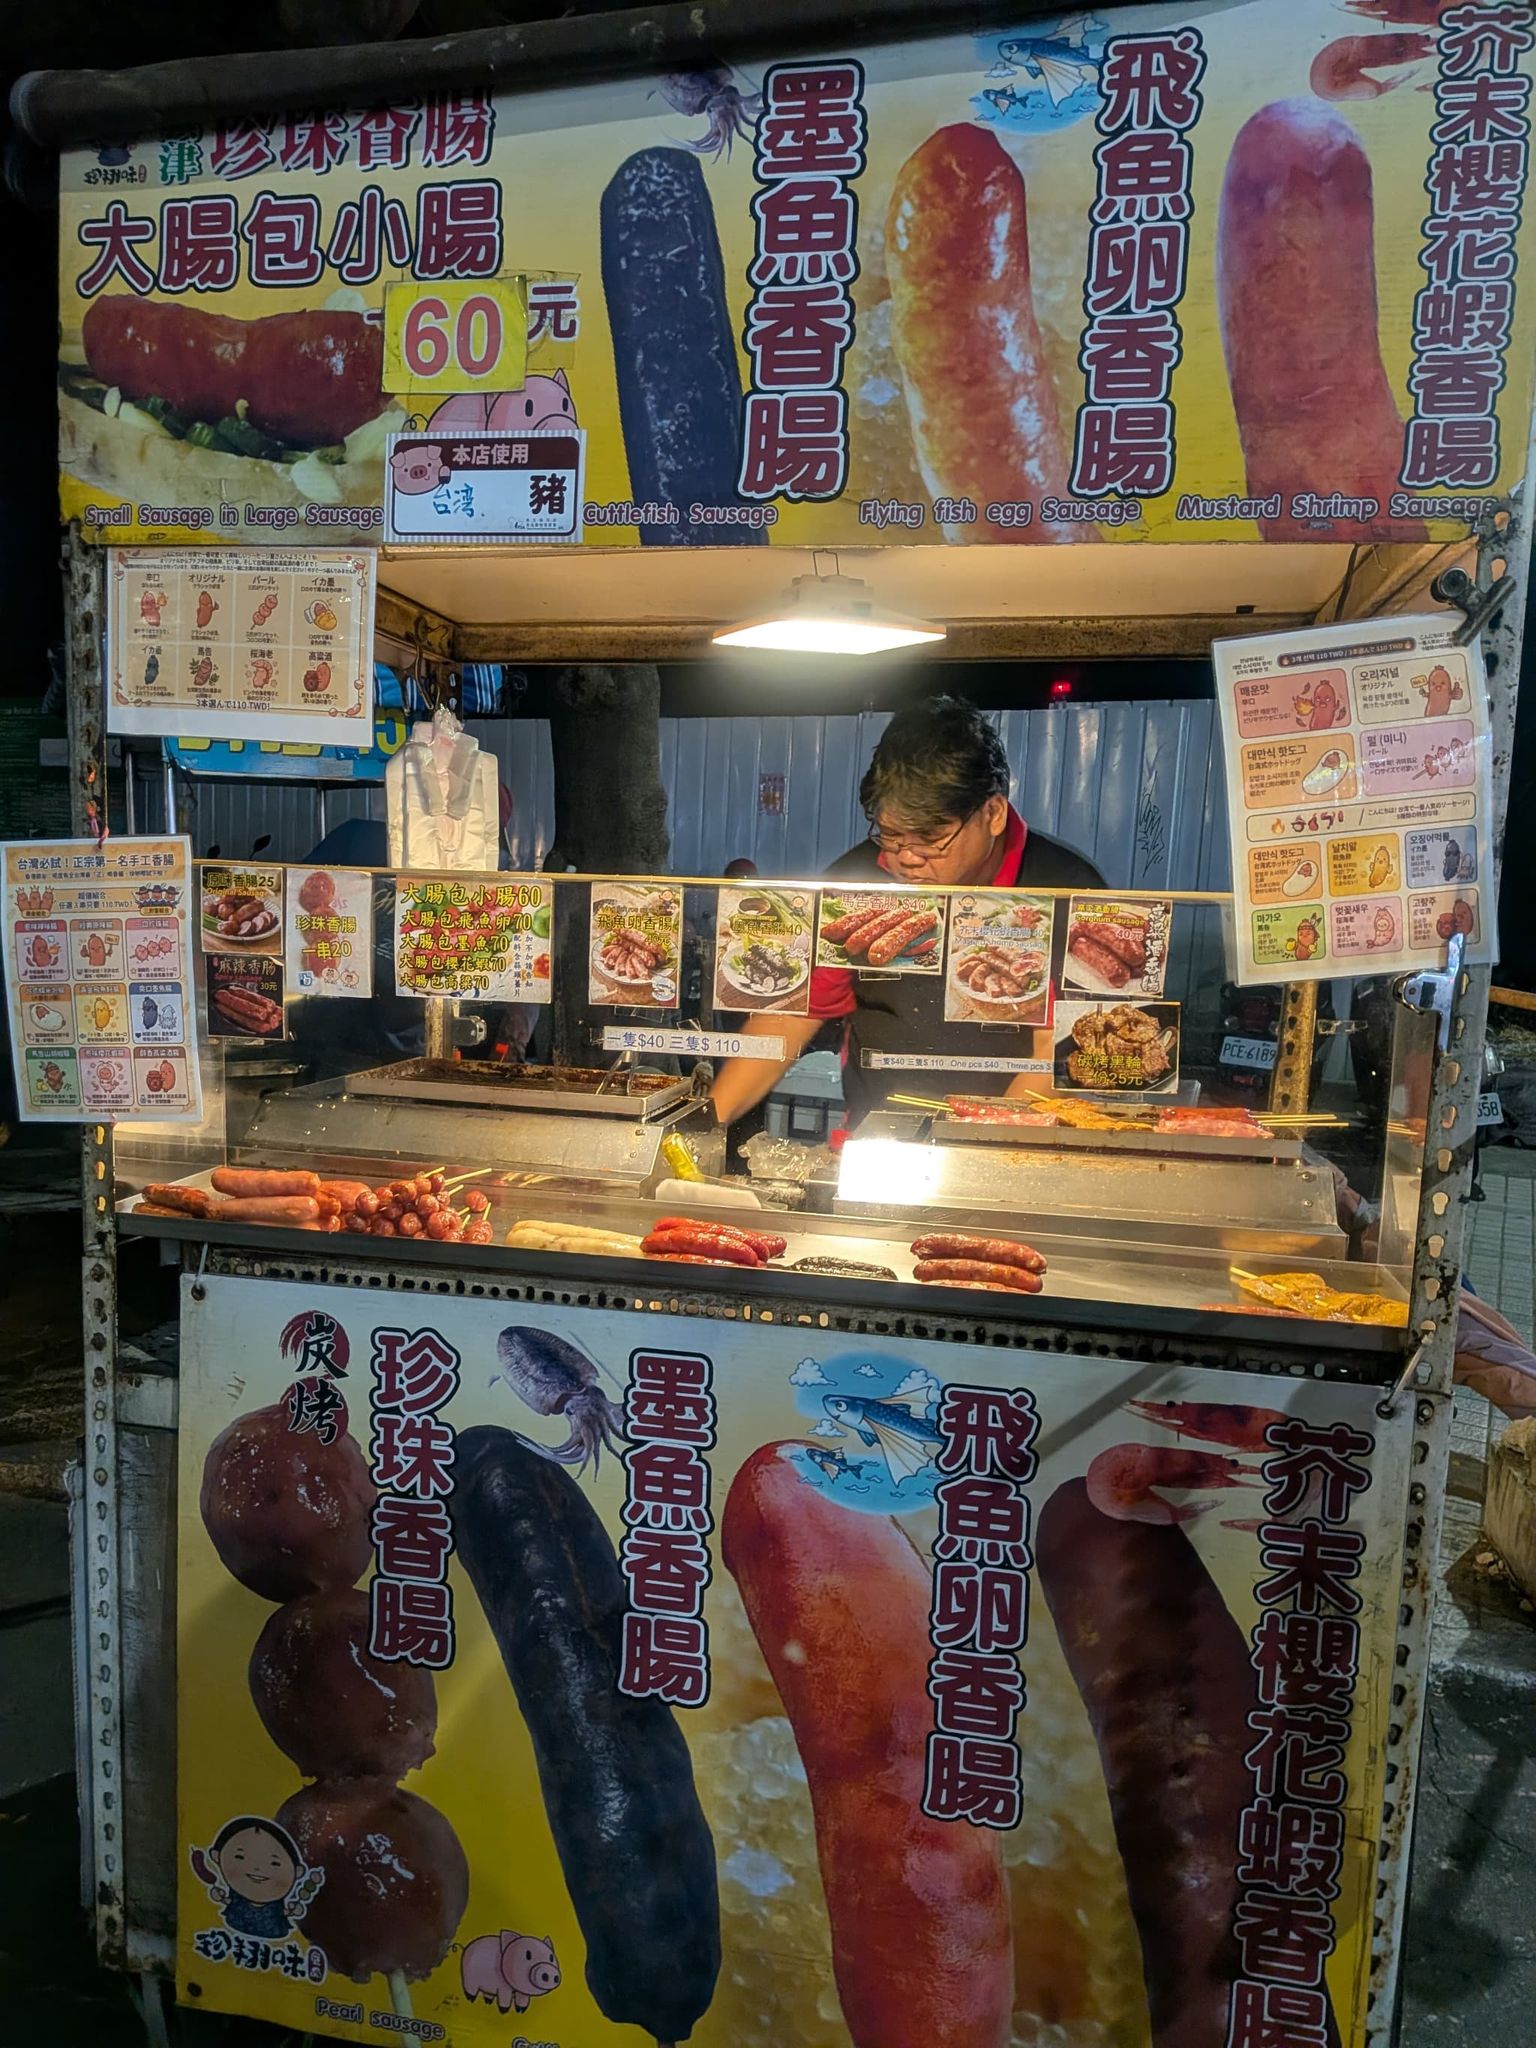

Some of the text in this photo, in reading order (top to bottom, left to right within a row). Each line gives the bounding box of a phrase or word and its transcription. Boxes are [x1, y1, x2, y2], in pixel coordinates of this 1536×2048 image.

[76, 179, 502, 298] 大腸包小腸
[1400, 5, 1534, 489] 芥末櫻花蝦香腸
[1070, 26, 1204, 497] 飛魚卵香腸
[737, 59, 866, 502] 墨魚香腸
[405, 296, 502, 378] 60
[452, 443, 529, 465] 本店使用
[529, 473, 567, 515] 豬
[85, 503, 384, 529] Small Sausage in Large Sausage
[582, 501, 679, 528] Cuttlefish
[687, 502, 778, 528] Sausage
[858, 498, 1142, 528] Flying fish egg Sausage
[1175, 495, 1281, 522] Mustard
[1291, 495, 1379, 524] Shrimp
[188, 574, 225, 583] オリジナル
[1360, 667, 1399, 680] 오리지널
[1361, 680, 1394, 690] オリジナル
[1380, 732, 1407, 746] (미니)
[1247, 744, 1307, 760] 대만식 핫도그
[1254, 850, 1278, 861] 대만식
[401, 882, 542, 907] 大腸包小腸60
[842, 892, 927, 911] 馬告香腸 $40
[295, 914, 357, 934] 珍珠香腸
[400, 911, 532, 931] 大腸包飛魚卵70
[598, 914, 672, 931] 飛魚卵香腸
[400, 933, 509, 952] 大腸包墨魚70
[1116, 928, 1144, 941] 40元
[302, 941, 352, 959] 一串20
[400, 954, 507, 972] 大腸包櫻花蝦70
[260, 982, 278, 991] 30元
[716, 1039, 740, 1053] 110
[951, 1060, 967, 1068] One
[288, 1312, 350, 1446] 炭烤
[369, 1325, 461, 1669] 珍珠香腸
[618, 1346, 717, 1707] 墨魚香腸
[920, 1383, 1041, 1831] 飛魚卵香腸
[1225, 1420, 1376, 2048] 芥末櫻花蝦香腸
[315, 1996, 446, 2041] Pearl sausage
